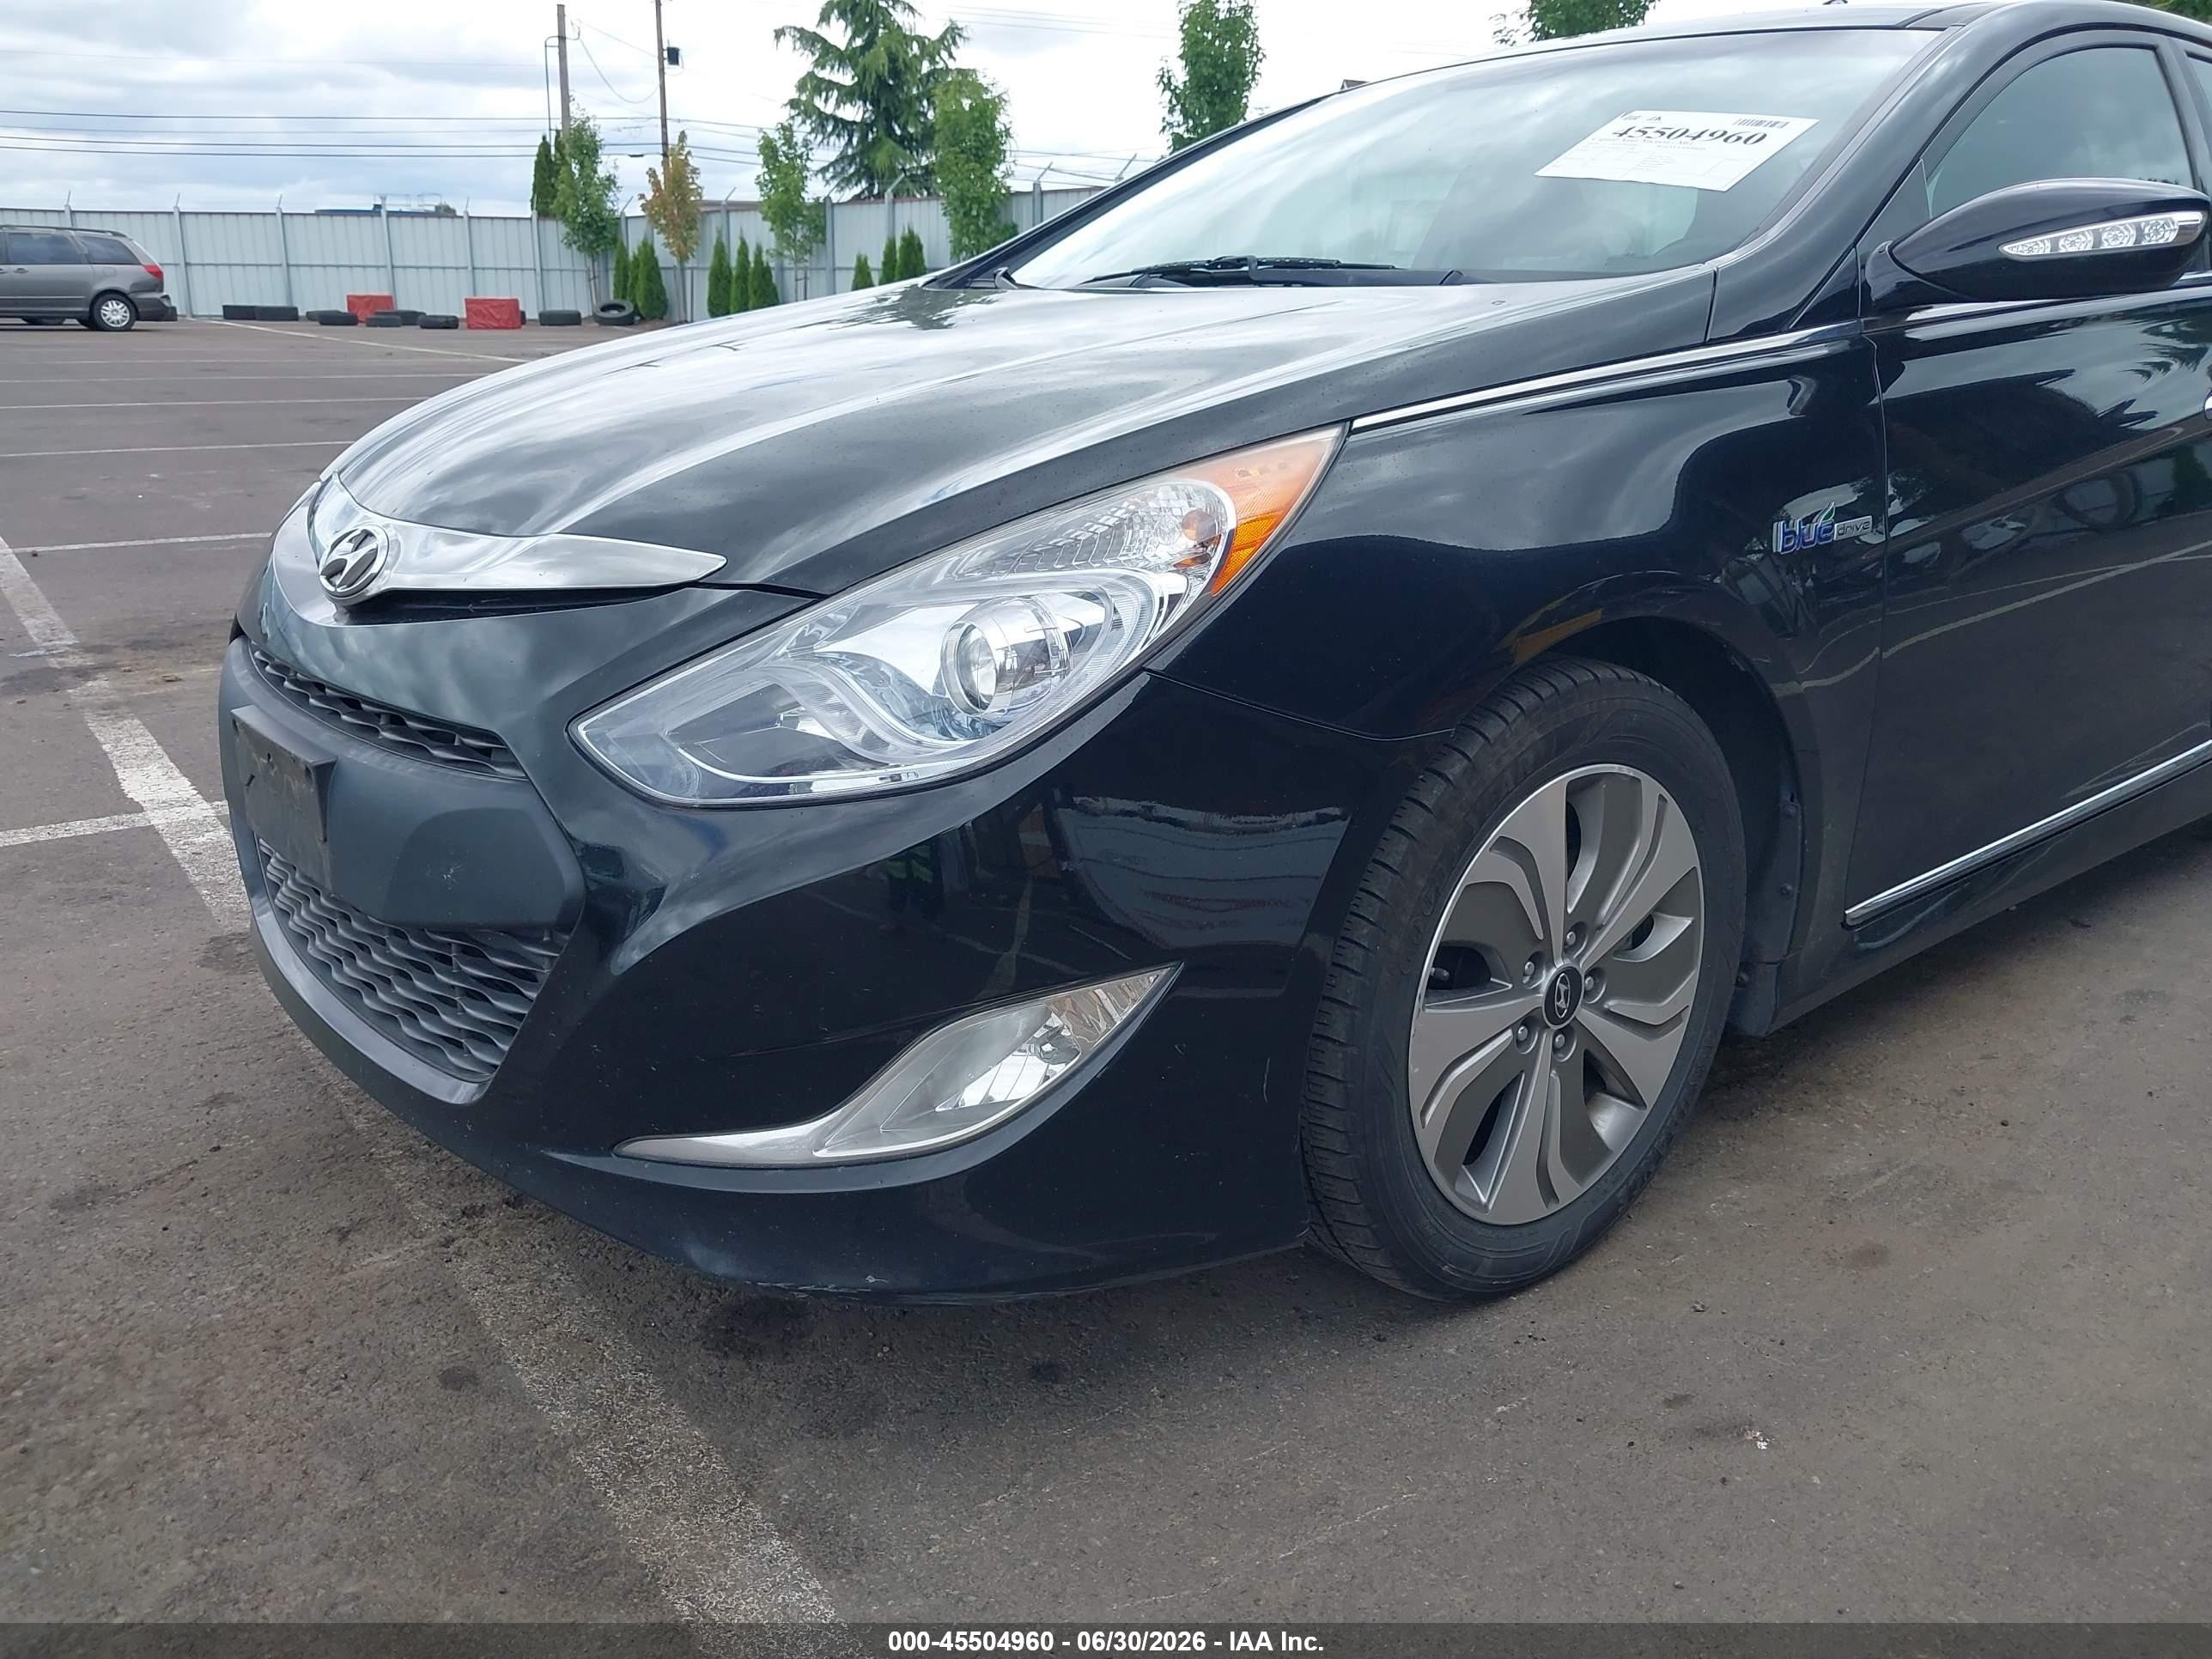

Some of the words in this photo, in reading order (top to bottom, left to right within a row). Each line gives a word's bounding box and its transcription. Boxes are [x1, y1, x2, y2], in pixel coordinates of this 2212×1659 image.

[1612, 125, 1768, 146] 45504960
[1774, 518, 1835, 555] blue
[1838, 520, 1871, 536] drive
